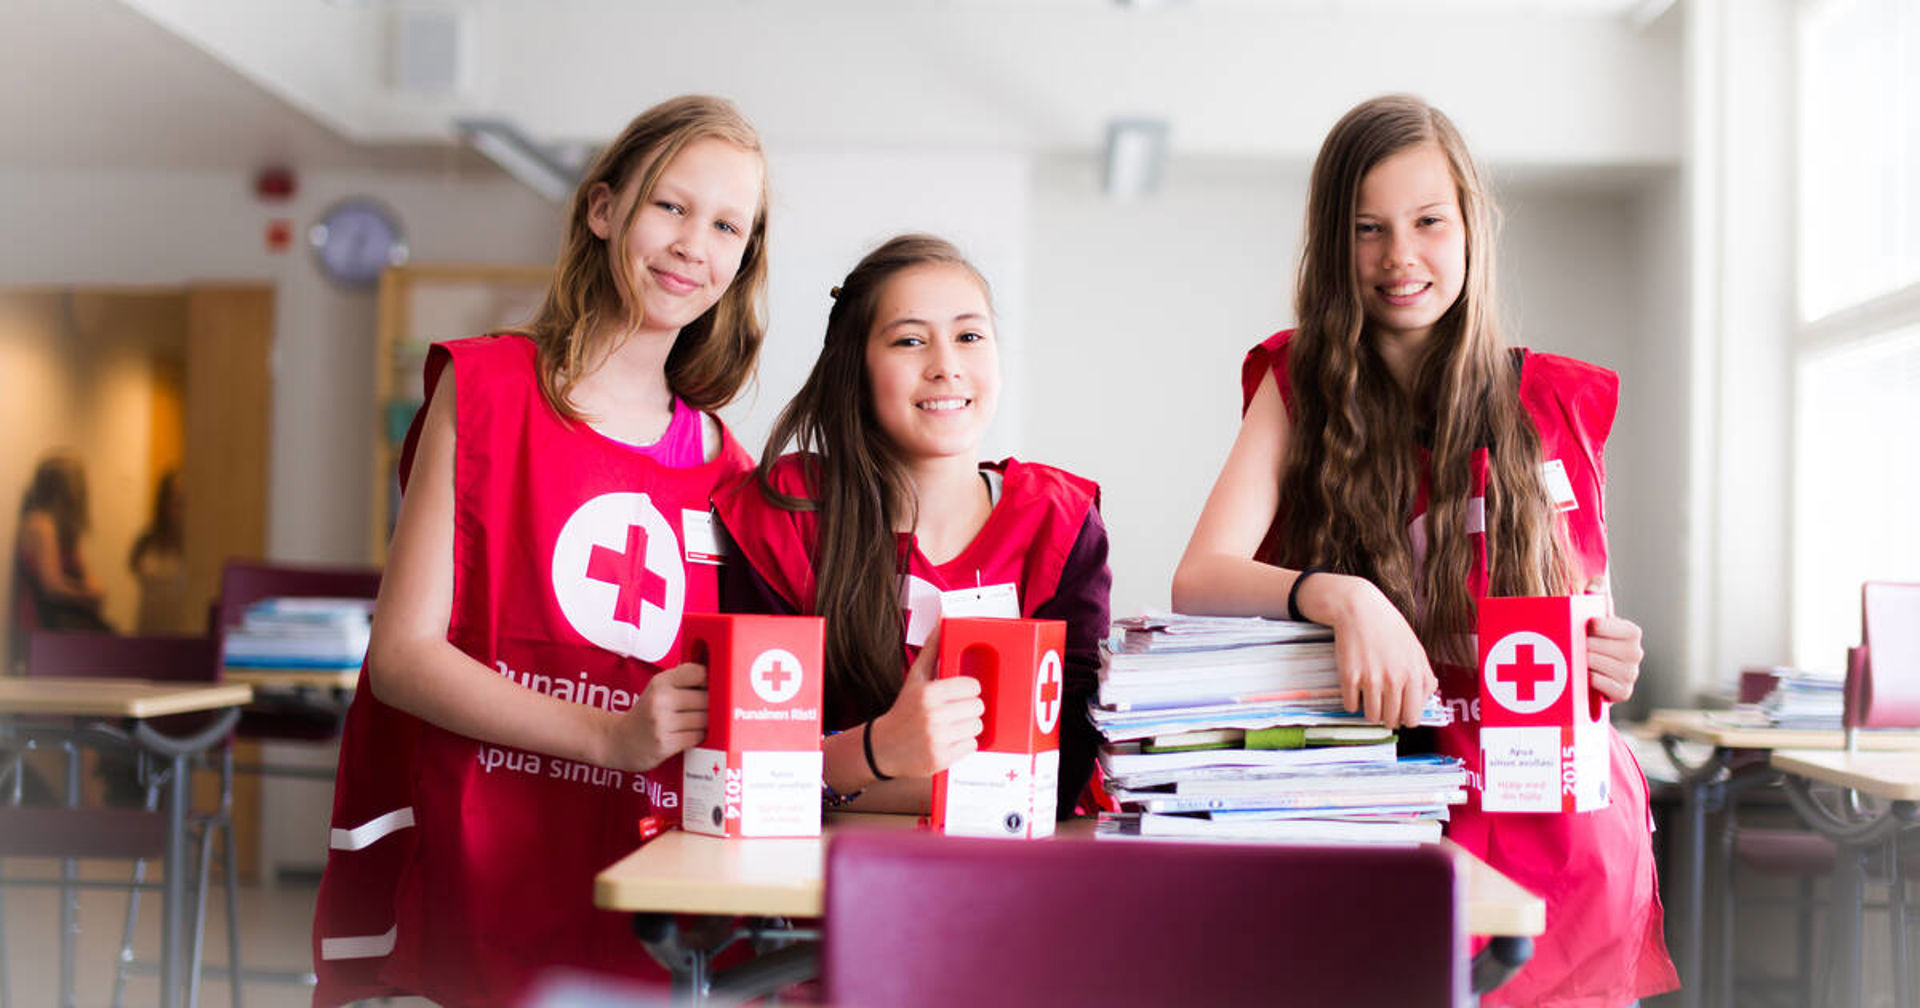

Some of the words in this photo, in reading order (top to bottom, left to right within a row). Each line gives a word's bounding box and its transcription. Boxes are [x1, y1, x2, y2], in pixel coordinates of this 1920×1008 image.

[496, 660, 641, 715] unaine
[550, 758, 623, 789] sinun
[726, 768, 741, 819] 2014
[1562, 746, 1577, 795] 2015
